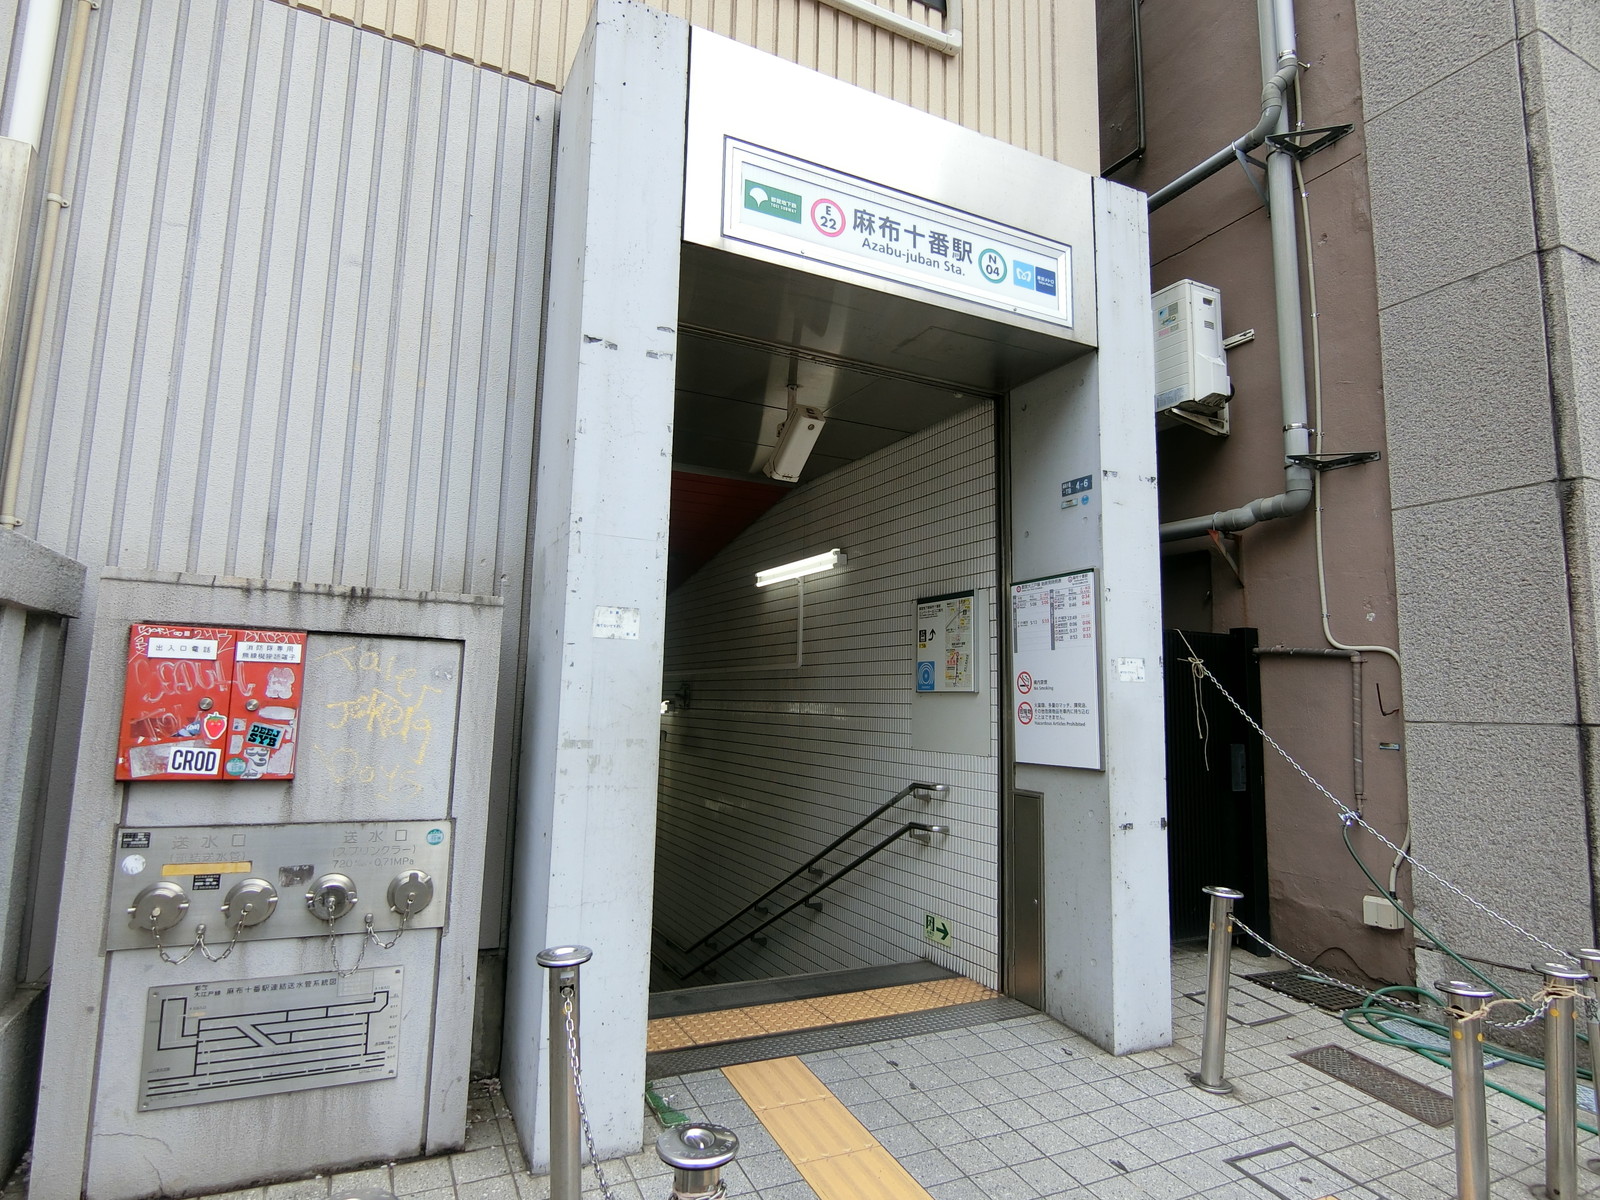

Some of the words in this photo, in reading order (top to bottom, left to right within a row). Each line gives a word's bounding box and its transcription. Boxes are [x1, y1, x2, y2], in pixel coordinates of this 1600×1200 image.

[825, 205, 832, 216] E
[820, 216, 837, 231] 22
[853, 208, 973, 265] 麻布十番駅
[862, 237, 940, 269] Azabu-juban
[944, 260, 966, 277] Sta.
[988, 254, 997, 265] N
[985, 264, 1000, 277] 04
[1075, 479, 1089, 490] 4-6
[156, 644, 211, 654] 出入口電話
[252, 724, 281, 738] DEEJ
[171, 749, 217, 772] CROD
[171, 833, 246, 849] 送水口
[343, 829, 408, 844] 送水口
